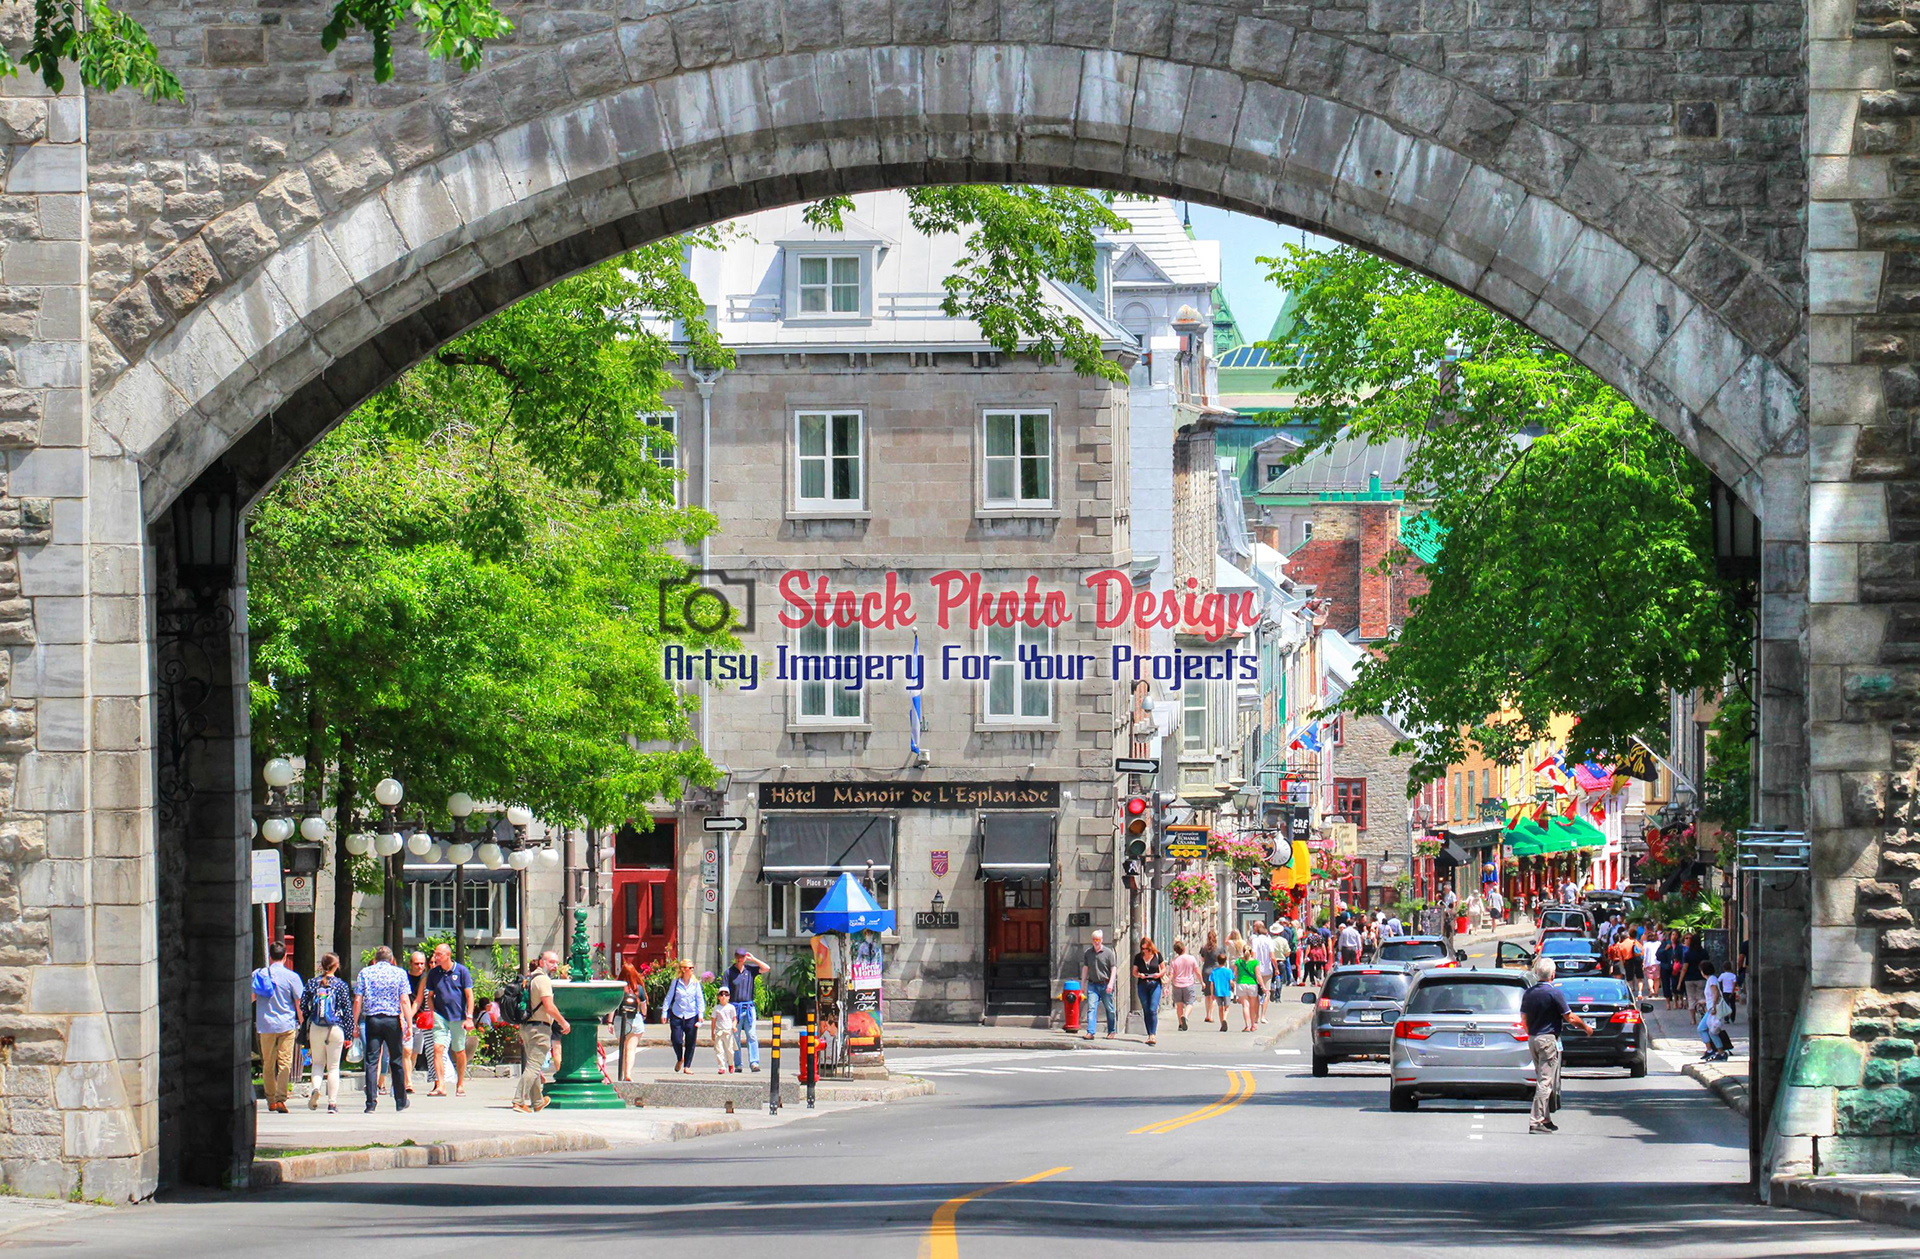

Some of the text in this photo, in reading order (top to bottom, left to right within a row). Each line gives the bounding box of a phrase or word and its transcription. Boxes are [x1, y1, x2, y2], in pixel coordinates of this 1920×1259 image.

[770, 785, 1049, 808] Hôtel Manoir de L'Esplanade
